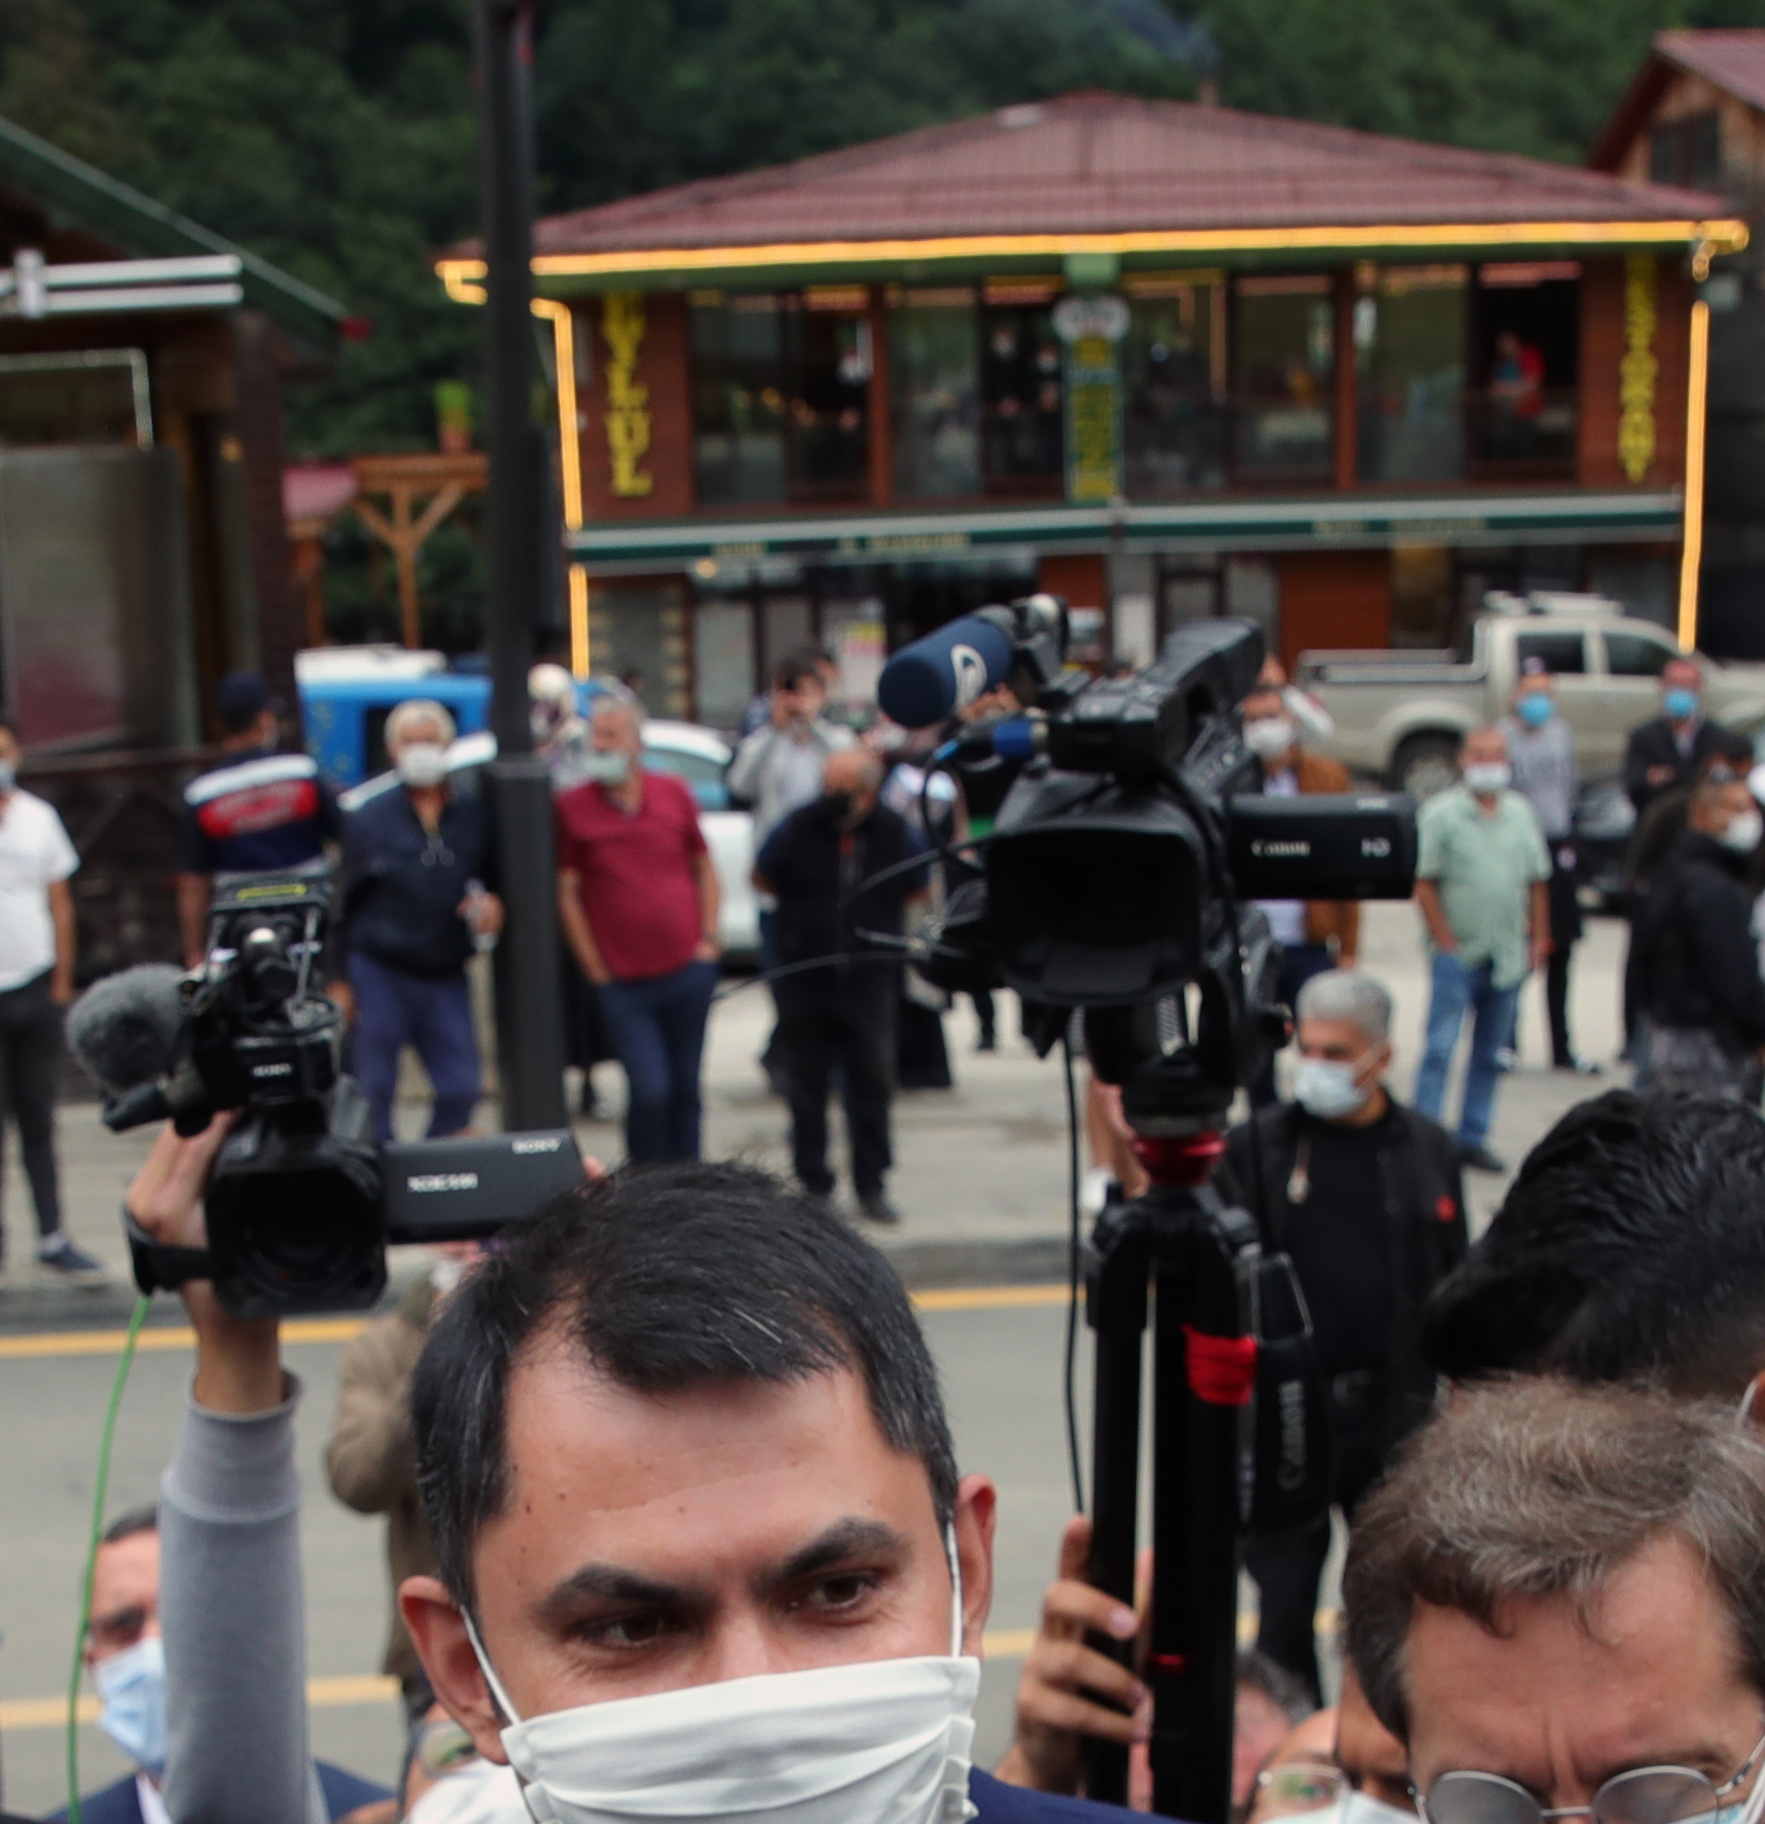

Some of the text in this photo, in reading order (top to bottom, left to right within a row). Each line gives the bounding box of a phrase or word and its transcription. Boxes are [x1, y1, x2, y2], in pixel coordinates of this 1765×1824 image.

[1250, 838, 1311, 857] Canon
[512, 1138, 561, 1154] SONY
[1277, 1380, 1307, 1491] Canon
